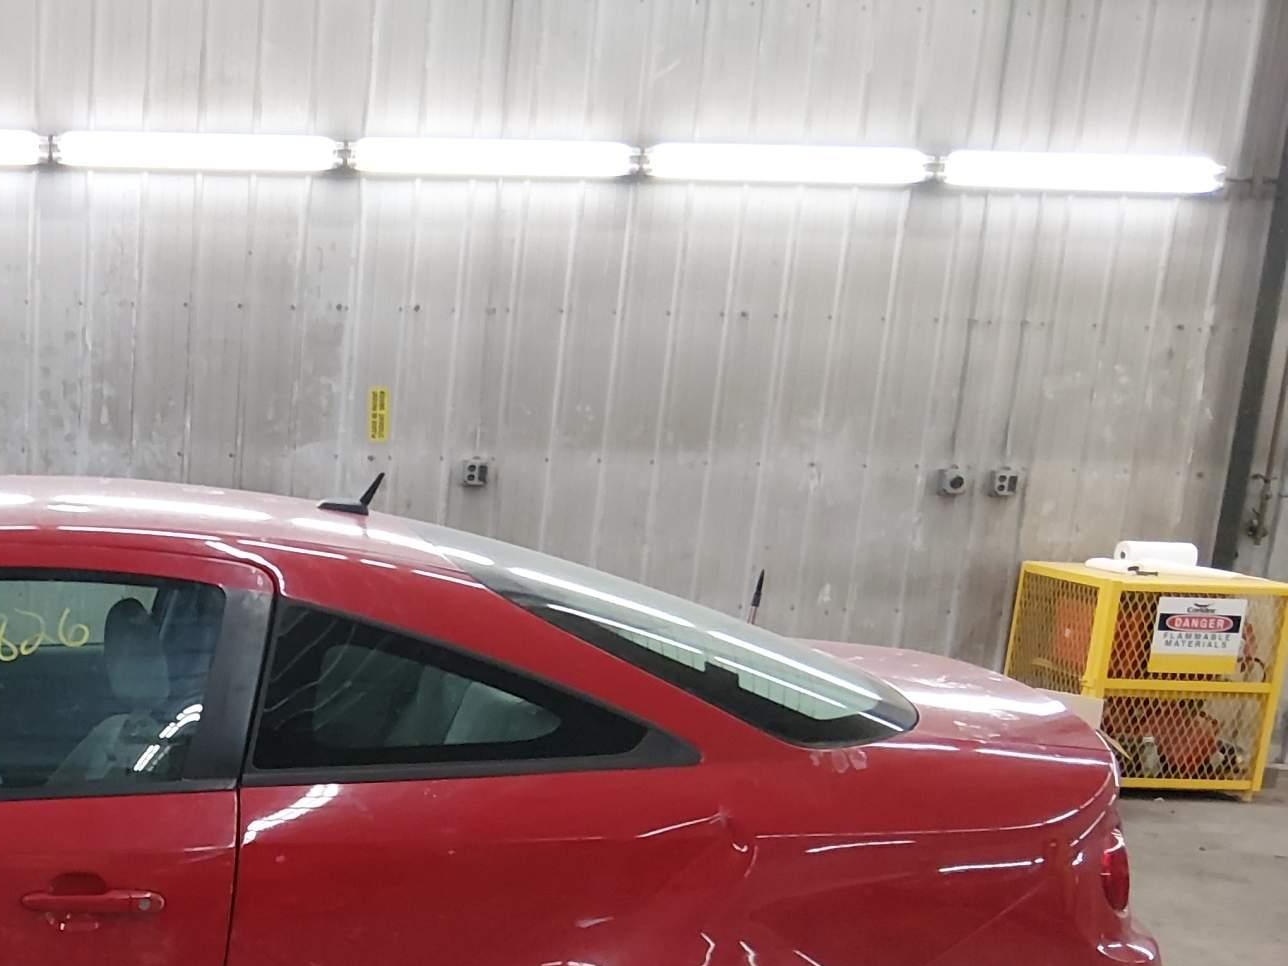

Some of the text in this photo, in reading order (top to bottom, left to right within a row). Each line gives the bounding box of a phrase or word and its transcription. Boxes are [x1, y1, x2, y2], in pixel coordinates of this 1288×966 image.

[1174, 617, 1225, 629] DANGER
[1163, 632, 1231, 641] FLAMMABLE
[1164, 639, 1226, 648] MATERIALS
